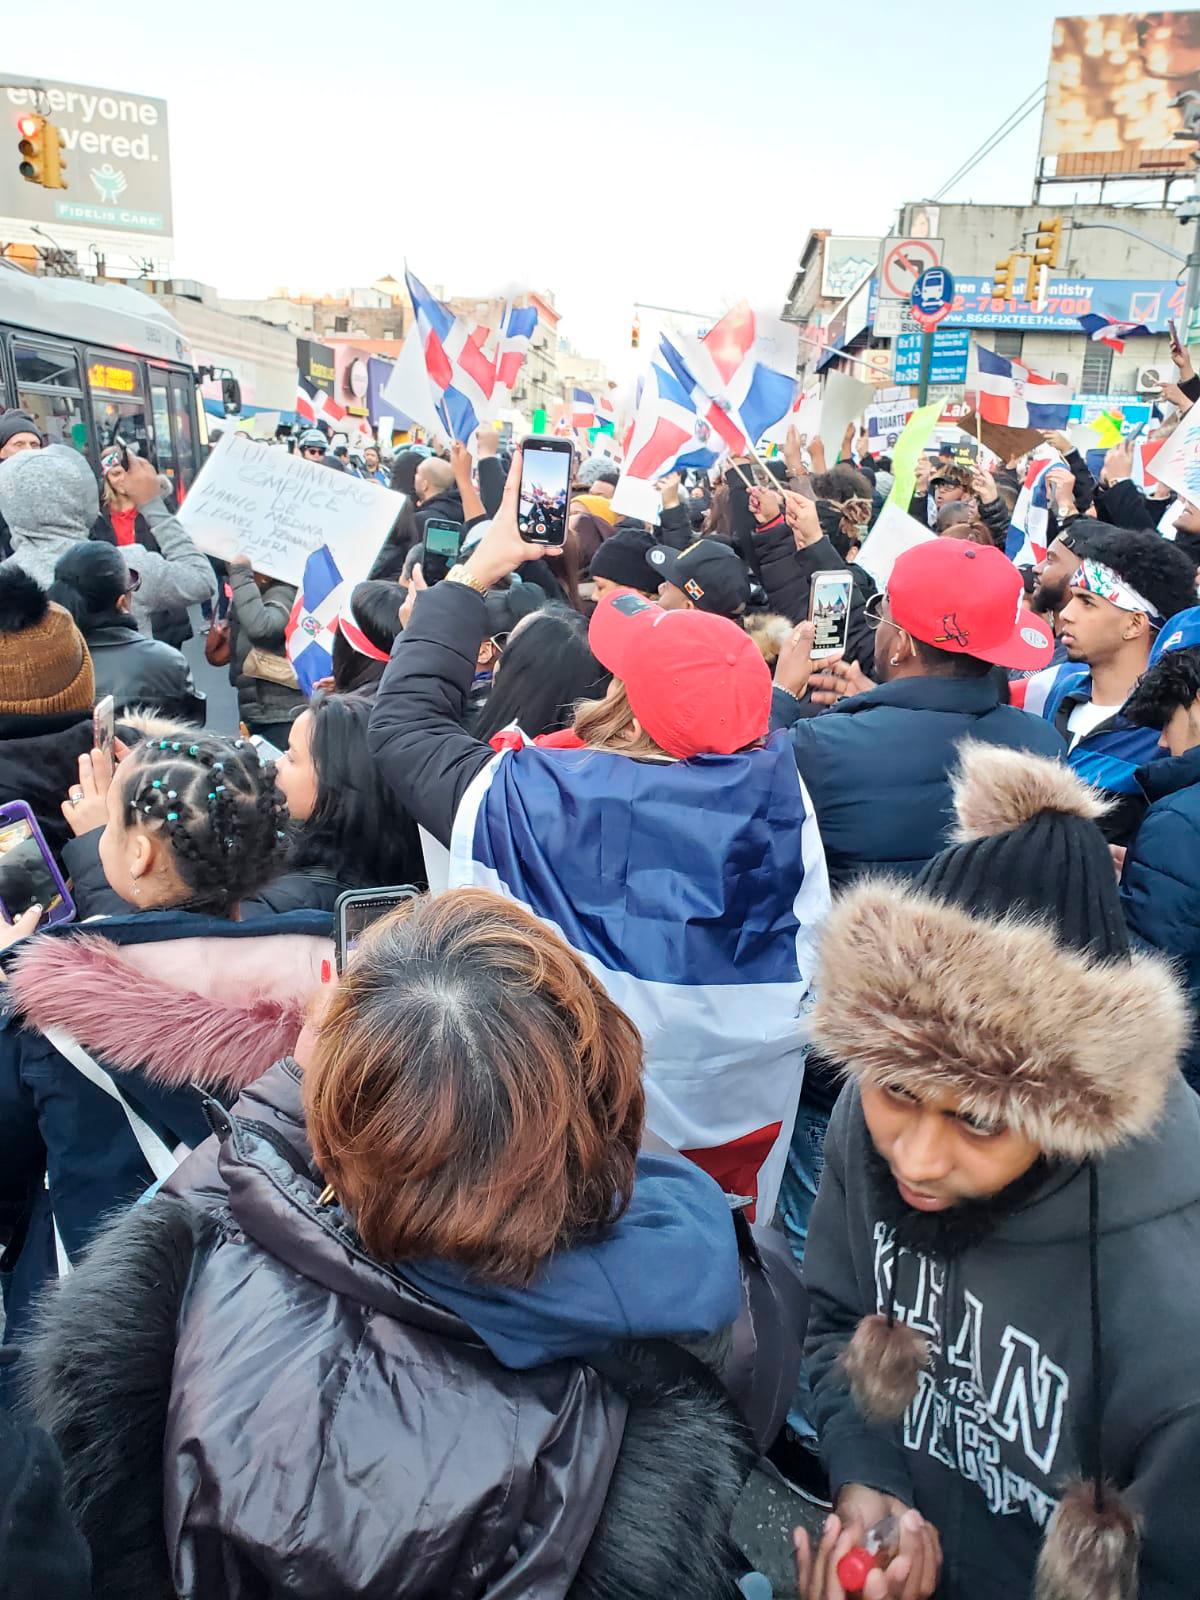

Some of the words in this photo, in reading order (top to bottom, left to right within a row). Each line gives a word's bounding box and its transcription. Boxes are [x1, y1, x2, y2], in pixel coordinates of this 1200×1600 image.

[59, 127, 159, 162] vered.
[59, 204, 115, 221] FIDELIS
[120, 212, 156, 226] CARE
[981, 282, 991, 294] &
[951, 294, 1092, 315] 2-781-700
[901, 322, 925, 332] BUSE
[943, 313, 1081, 327] ww.866FIXTEETH.co
[942, 401, 972, 417] Lab
[878, 413, 905, 430] DUARTE
